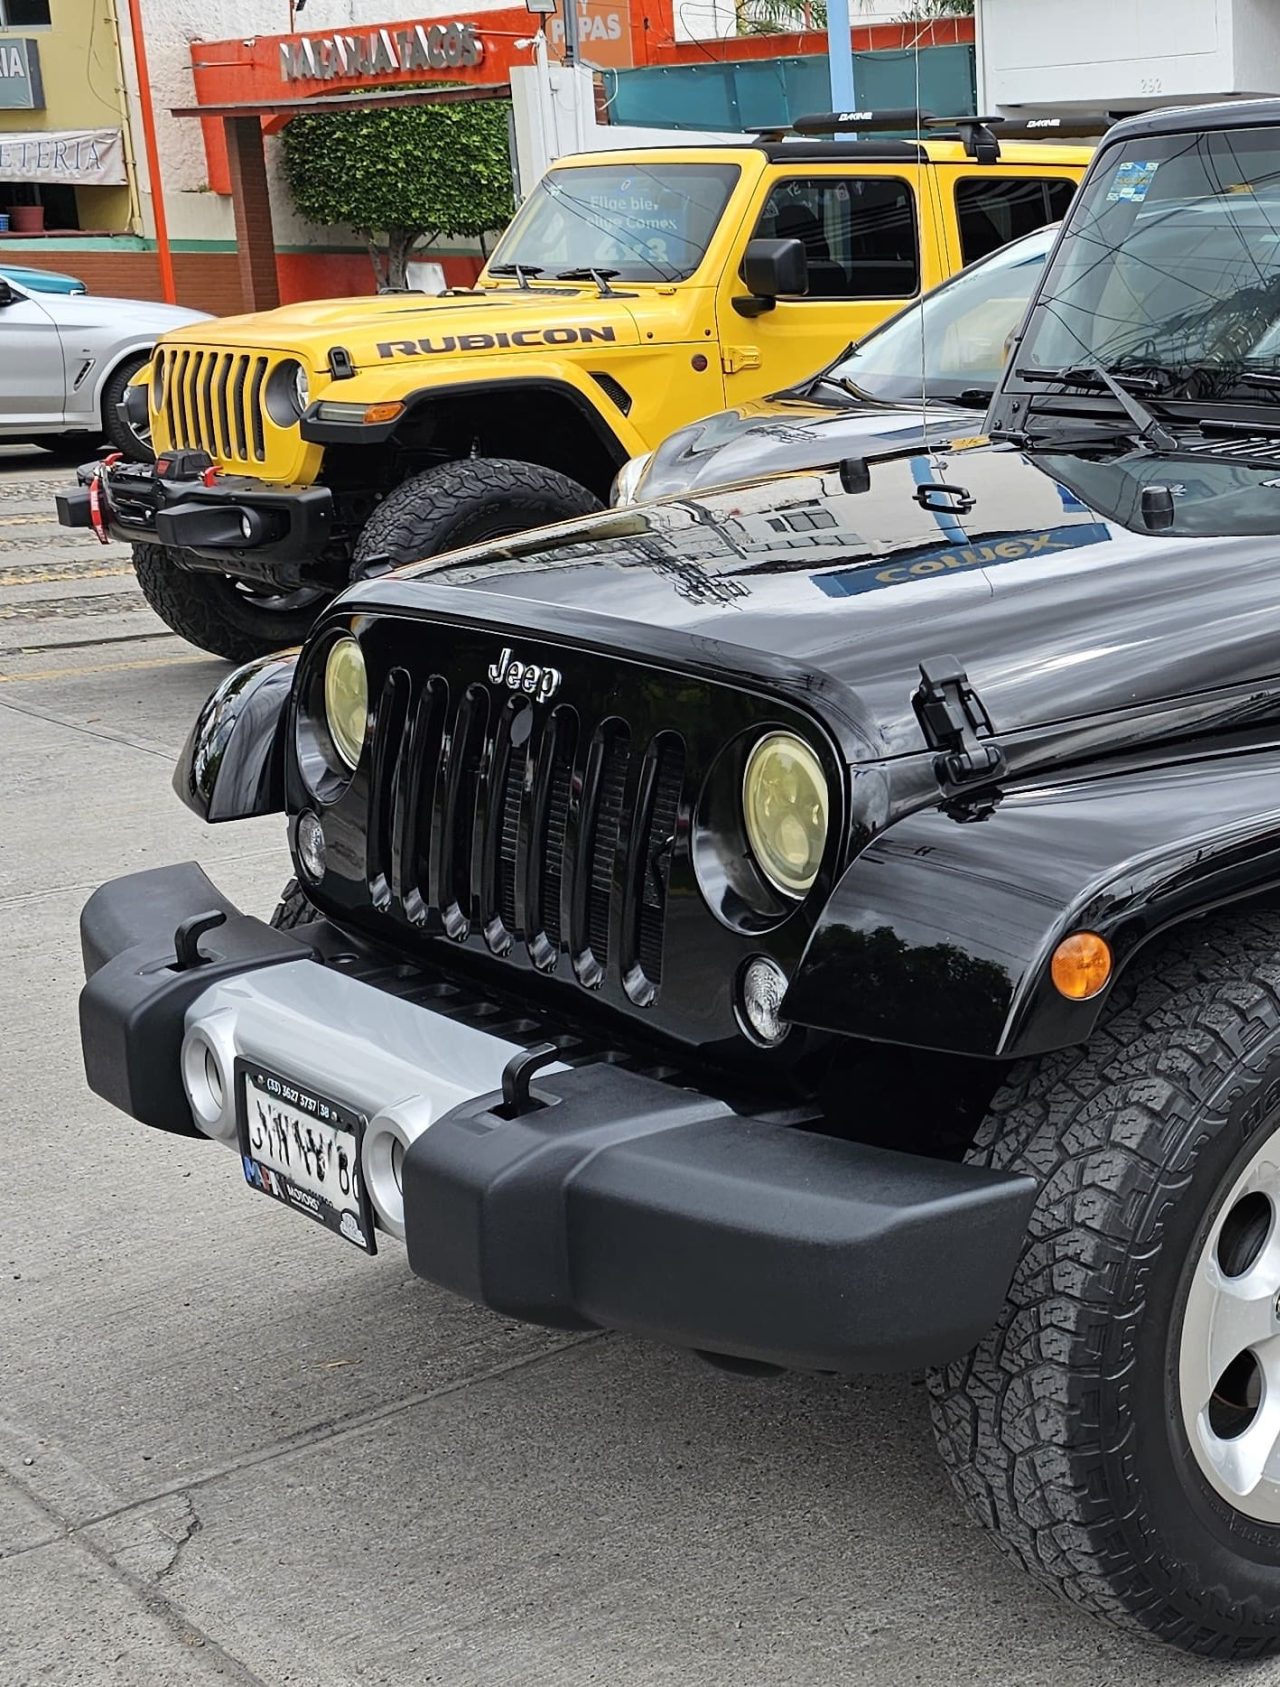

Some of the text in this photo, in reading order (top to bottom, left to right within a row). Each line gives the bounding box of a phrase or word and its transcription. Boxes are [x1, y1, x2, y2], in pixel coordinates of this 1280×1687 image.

[551, 13, 622, 44] PPAS
[0, 46, 25, 78] IA
[394, 21, 485, 72] TACOS
[376, 326, 616, 358] RUBICON
[488, 648, 563, 704] Jeep
[267, 1077, 282, 1095] (33)
[286, 1183, 320, 1211] MOTORS
